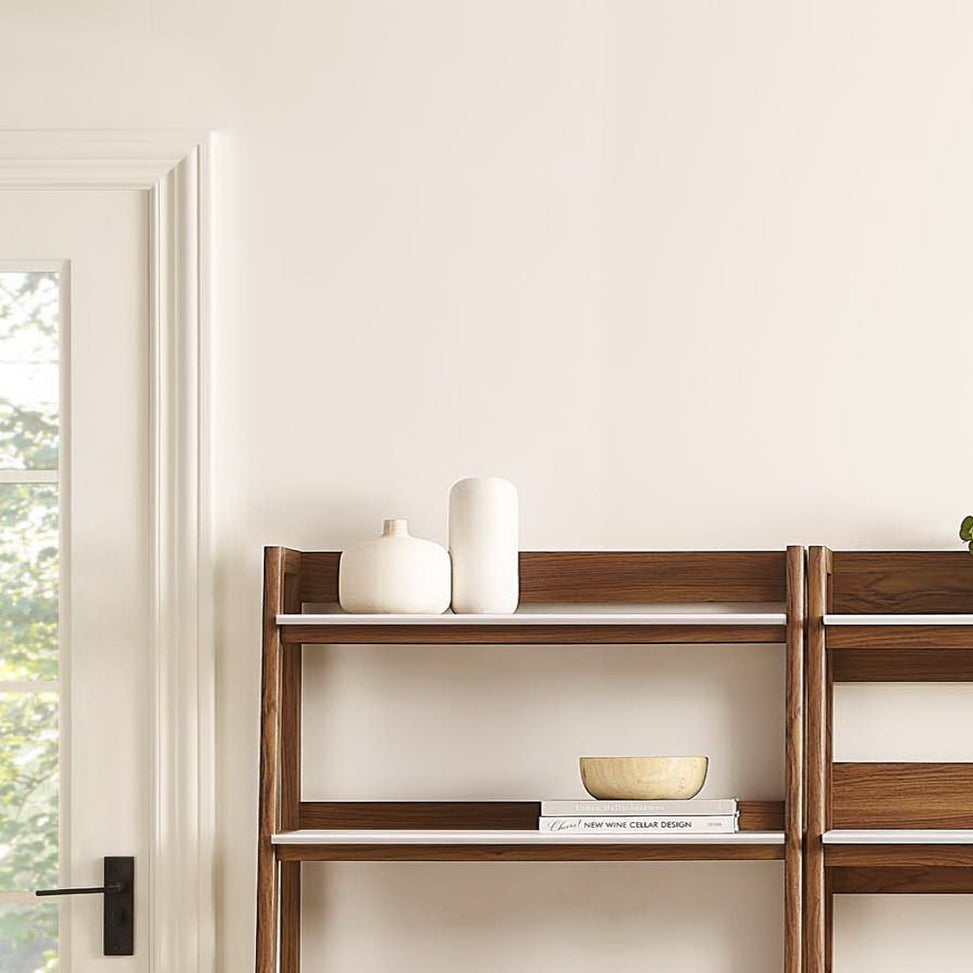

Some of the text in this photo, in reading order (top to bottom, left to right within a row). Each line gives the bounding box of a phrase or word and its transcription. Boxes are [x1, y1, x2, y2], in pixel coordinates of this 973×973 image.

[583, 821, 604, 829] NEW
[605, 821, 627, 829] WINE
[628, 821, 659, 829] CELLAR
[660, 821, 692, 829] DESIGN
